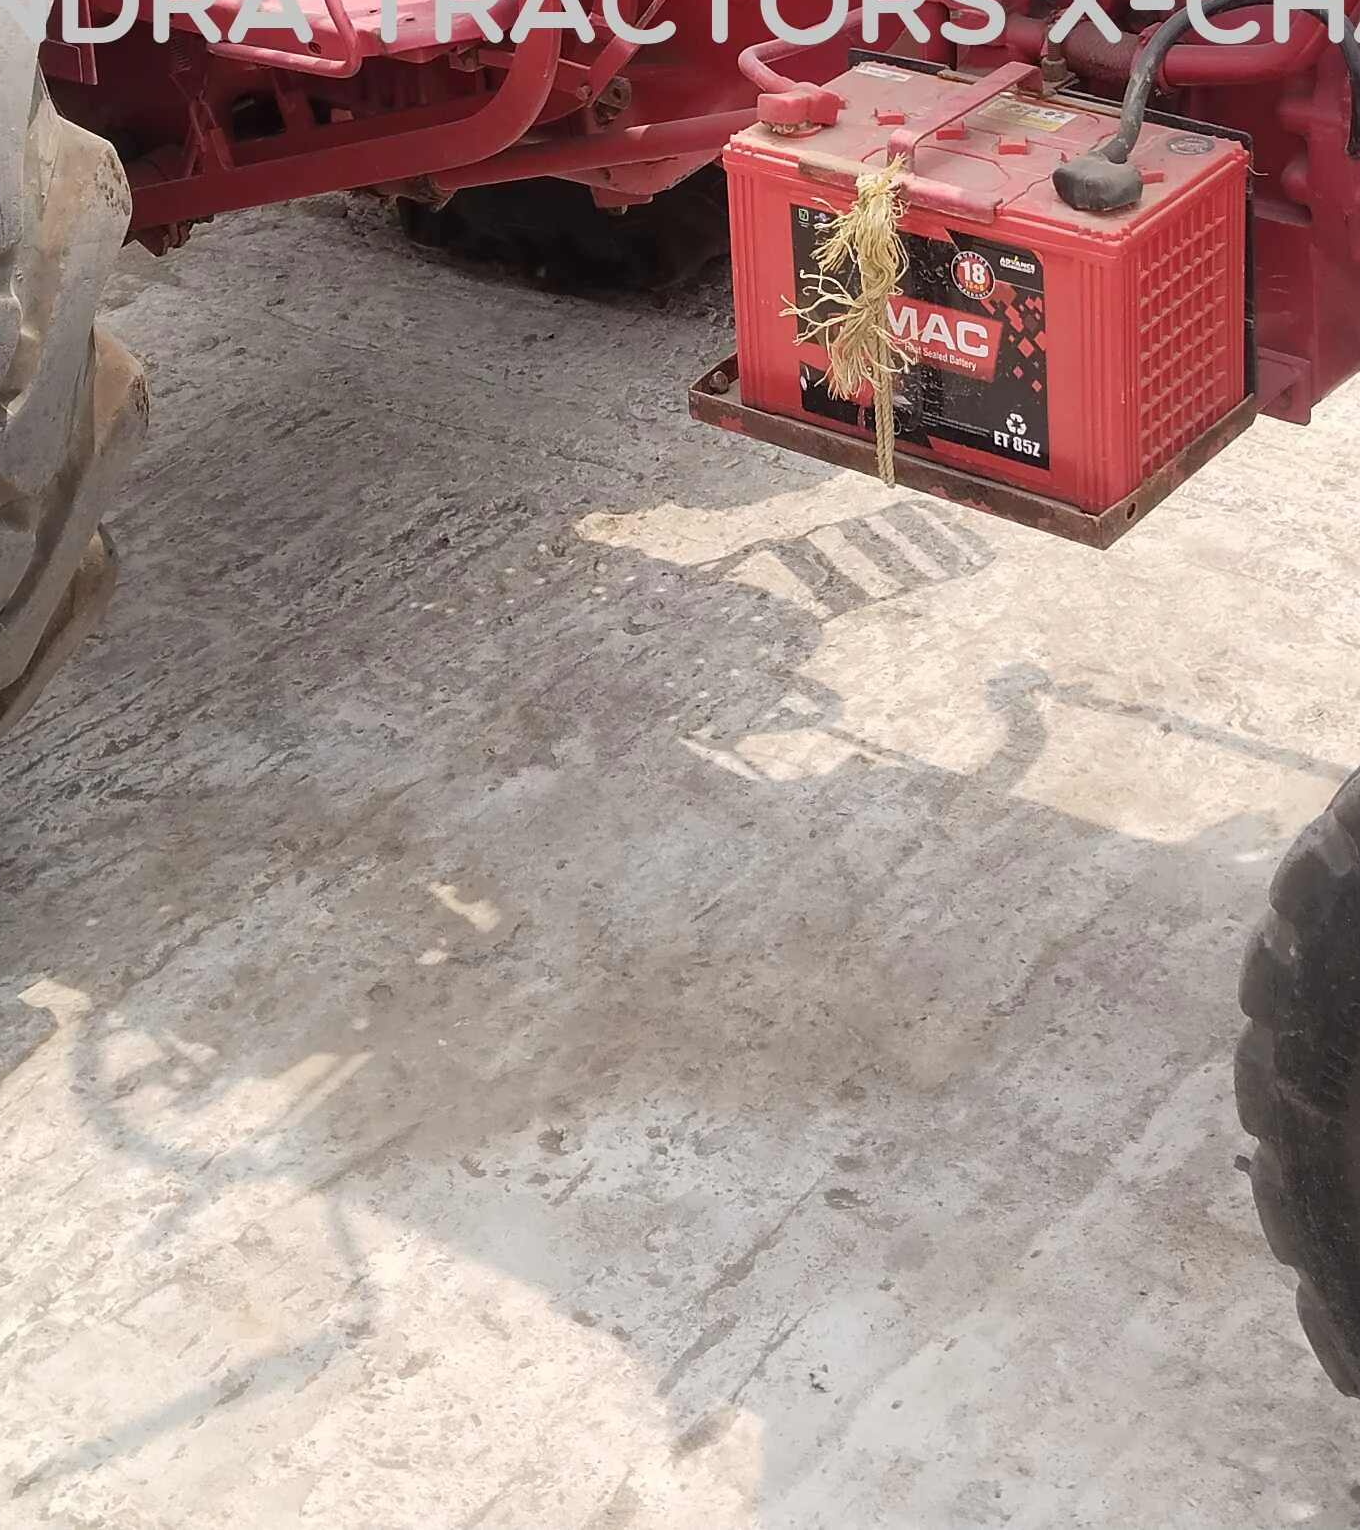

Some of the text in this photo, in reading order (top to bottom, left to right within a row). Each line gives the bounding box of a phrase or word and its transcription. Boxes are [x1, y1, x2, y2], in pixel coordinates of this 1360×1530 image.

[959, 261, 986, 285] 18
[949, 355, 977, 372] Battery
[993, 430, 1010, 448] ET
